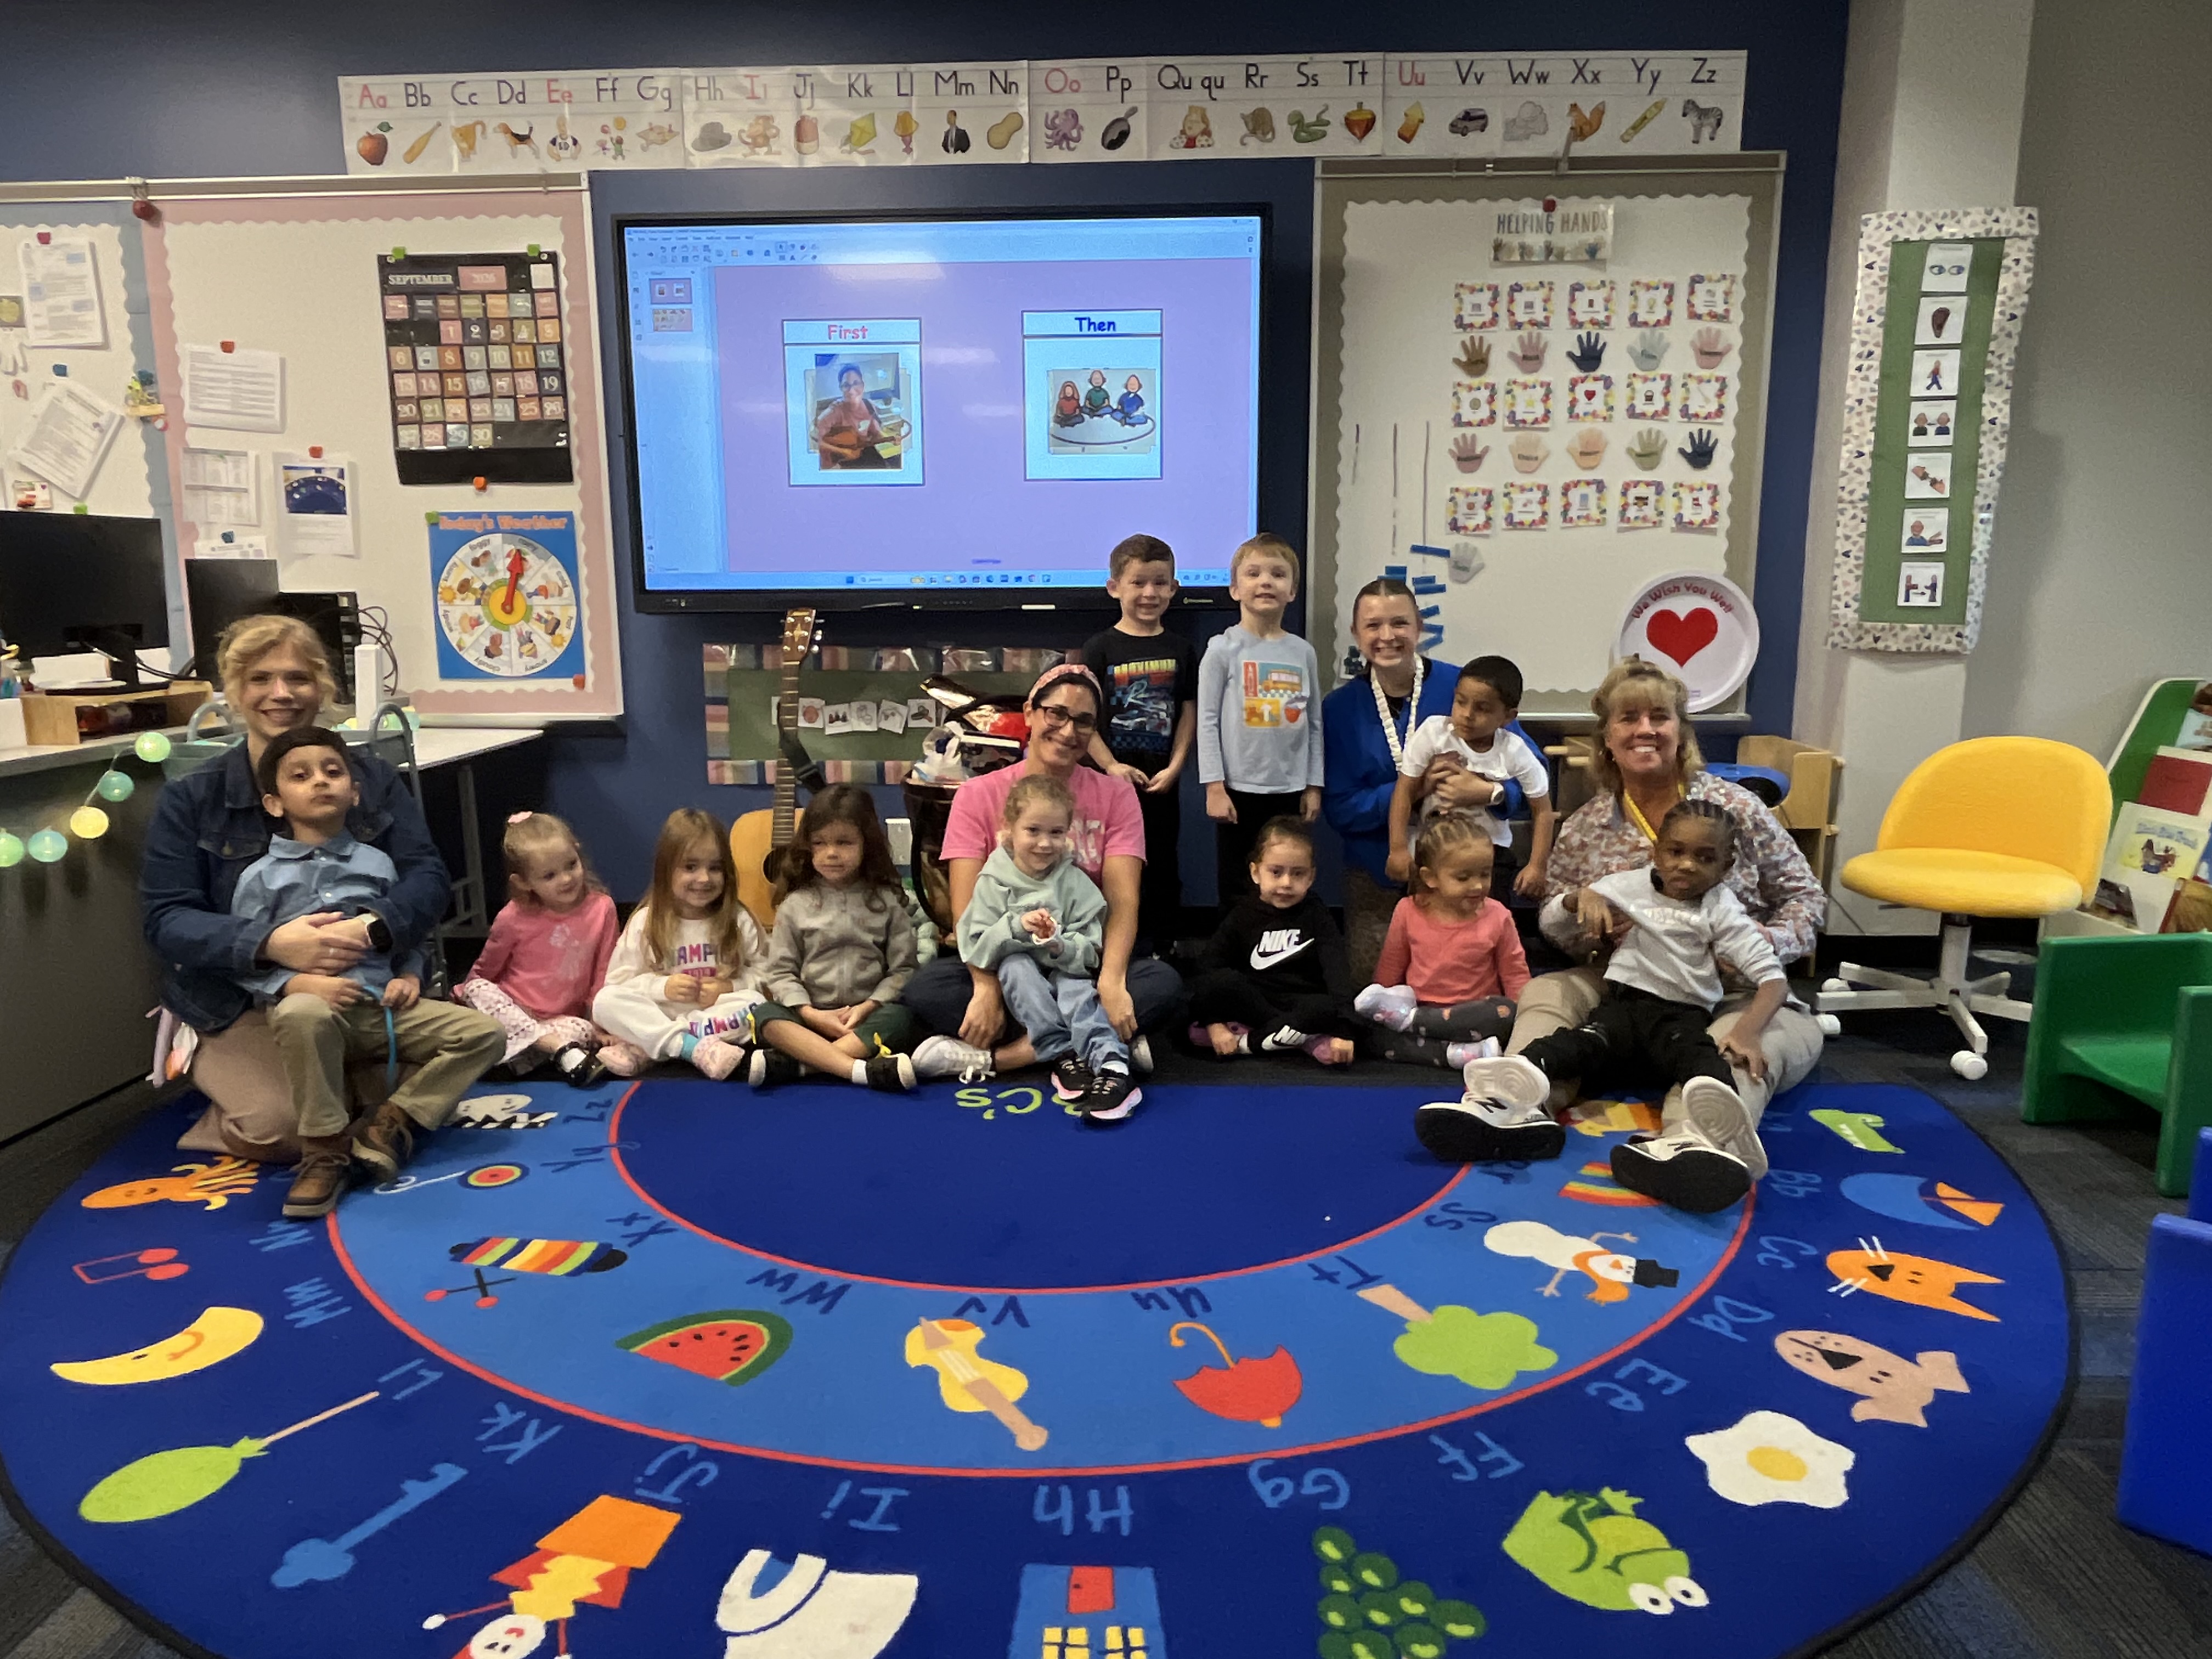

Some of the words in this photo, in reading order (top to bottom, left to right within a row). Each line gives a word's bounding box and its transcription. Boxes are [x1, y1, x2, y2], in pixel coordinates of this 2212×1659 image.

[358, 84, 387, 109] Aa
[404, 83, 432, 107] Bb
[451, 81, 478, 106] Cc
[497, 80, 526, 105] Dd
[546, 79, 572, 104] Ee
[595, 77, 618, 102] Ff
[636, 76, 672, 111] Gg
[695, 76, 724, 101] Hh
[793, 73, 815, 110] Jj
[848, 72, 873, 98] Kk
[934, 70, 975, 95] Mm
[989, 70, 1019, 94] Nn
[1045, 67, 1081, 93] Oo
[1105, 66, 1132, 103] Pp
[1158, 64, 1192, 91] Qu
[1200, 75, 1224, 101] qu
[1245, 63, 1268, 88] Rr
[1296, 61, 1319, 87] Ss
[1343, 60, 1368, 86] Tt
[1398, 60, 1426, 86] Uu
[1455, 60, 1485, 84] Vv
[1508, 59, 1550, 84] Ww
[1571, 58, 1601, 84] Xx
[1630, 58, 1661, 95] Yy
[1690, 58, 1717, 83] Zz
[1497, 211, 1554, 234] HELPING
[1561, 211, 1609, 233] HANDS
[447, 325, 454, 337] 1
[470, 325, 482, 338] 2
[544, 324, 554, 336] 5
[827, 324, 868, 340] First
[1074, 317, 1116, 332] Then
[396, 351, 407, 365] 6
[444, 351, 455, 364] 8
[470, 351, 479, 365] 9
[492, 349, 506, 364] 10
[516, 350, 529, 364] 11
[540, 349, 556, 364] 12
[447, 377, 462, 391] 15
[517, 375, 534, 390] 18
[542, 376, 558, 391] 19
[397, 404, 417, 417] 20
[423, 403, 440, 417] 21
[518, 401, 539, 415] 25
[448, 428, 467, 443] 29
[472, 428, 490, 441] 30
[1632, 601, 1650, 619] We
[1648, 583, 1681, 601] Wish
[1684, 582, 1707, 595] You
[1710, 590, 1735, 613] Well
[1258, 928, 1301, 953] NIKE
[541, 1141, 641, 1173] Yy
[1767, 1169, 1822, 1198] Bb
[606, 1211, 678, 1248] Xx
[1756, 1235, 1819, 1268] Cc
[1307, 1255, 1384, 1290] Tt
[283, 1277, 352, 1329] Mm
[746, 1267, 852, 1314] Ww
[1131, 1285, 1212, 1319] Uu
[952, 1294, 1030, 1328] Vv
[1686, 1294, 1776, 1342] Dd
[1585, 1356, 1691, 1413] Ee
[475, 1401, 564, 1465] Kk
[634, 1442, 720, 1504] Jj
[1428, 1431, 1525, 1483] Ff
[1248, 1459, 1351, 1510] Gg
[1032, 1484, 1133, 1535] Hh
